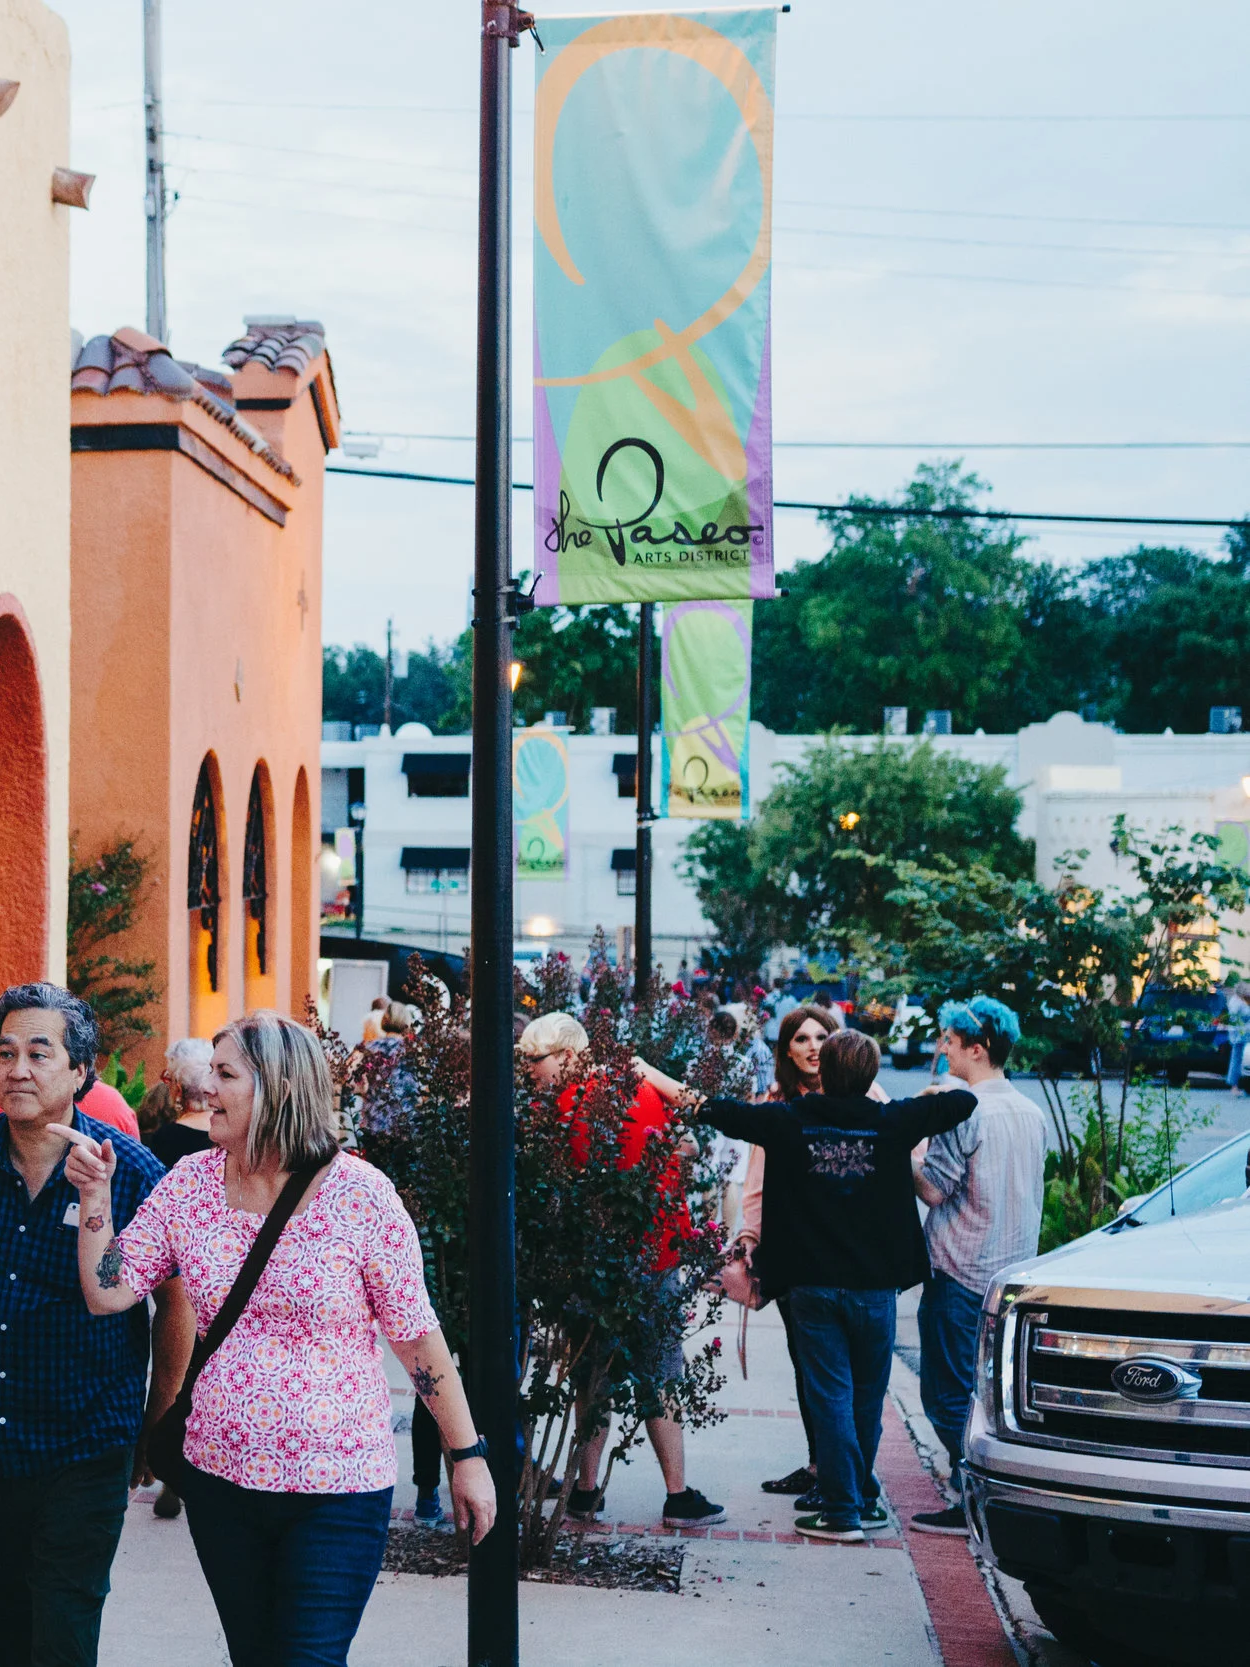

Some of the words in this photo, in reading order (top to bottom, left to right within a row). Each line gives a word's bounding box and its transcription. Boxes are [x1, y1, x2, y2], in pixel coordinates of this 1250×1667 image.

[576, 437, 764, 567] Paseo
[633, 550, 672, 565] ARTS
[678, 548, 750, 563] DISTRICT
[1122, 1365, 1163, 1388] Ford
